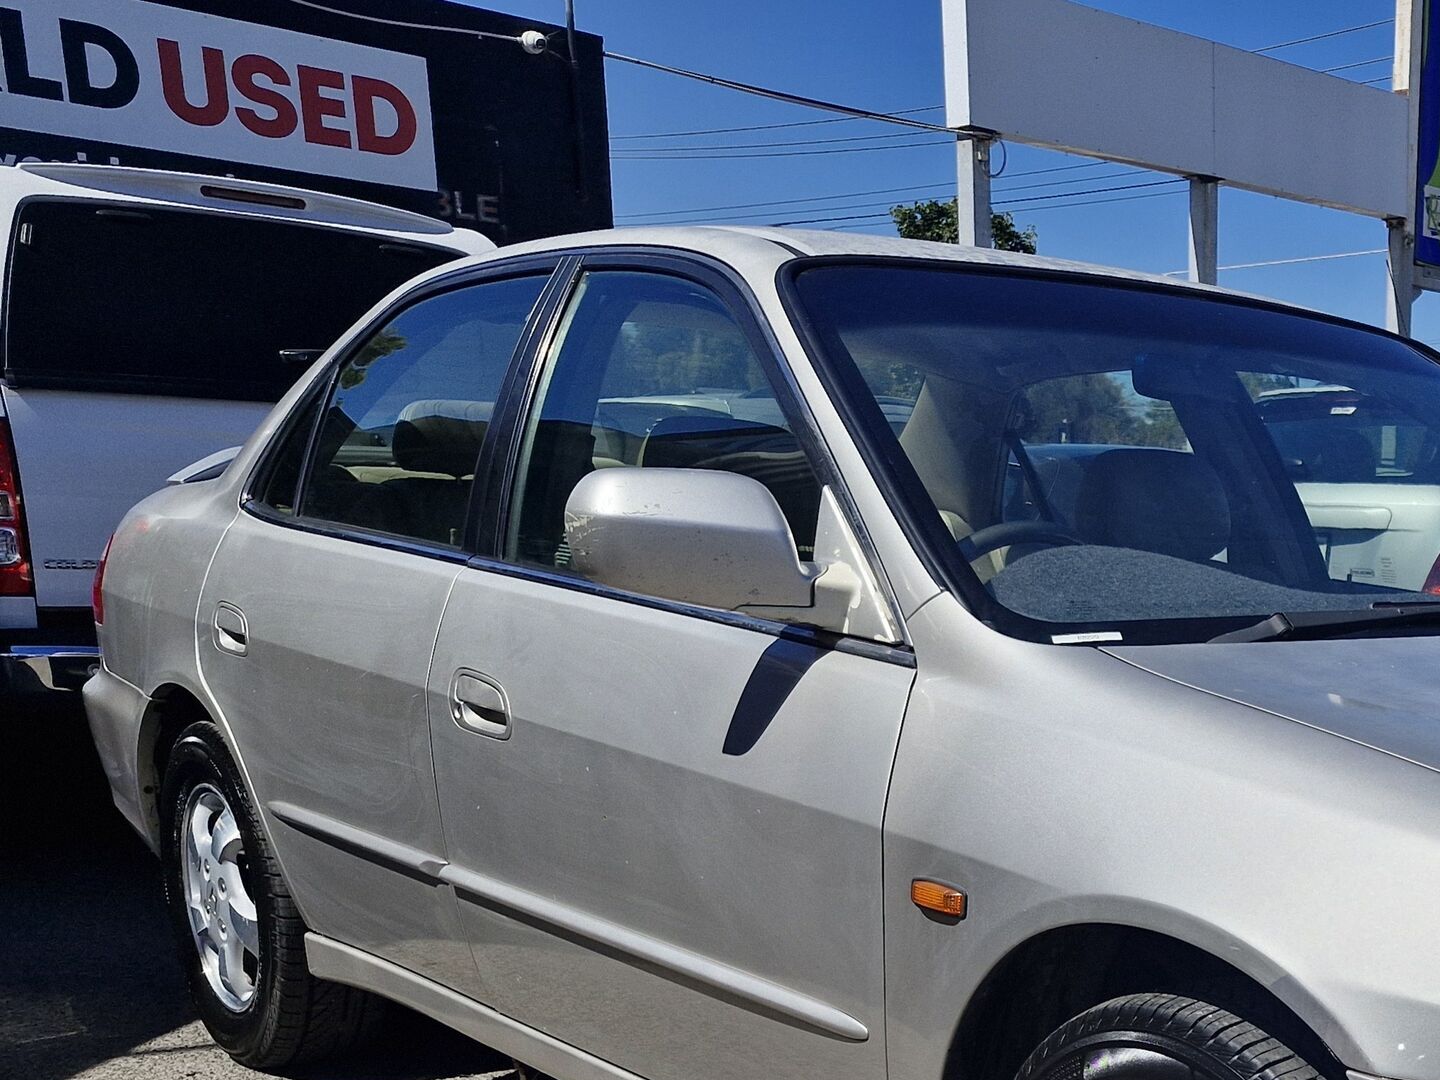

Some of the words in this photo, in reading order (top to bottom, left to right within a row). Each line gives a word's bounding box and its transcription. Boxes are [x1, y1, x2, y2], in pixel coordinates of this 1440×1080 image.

[0, 6, 140, 110] LD
[156, 37, 418, 156] USED
[44, 559, 97, 569] COLO
